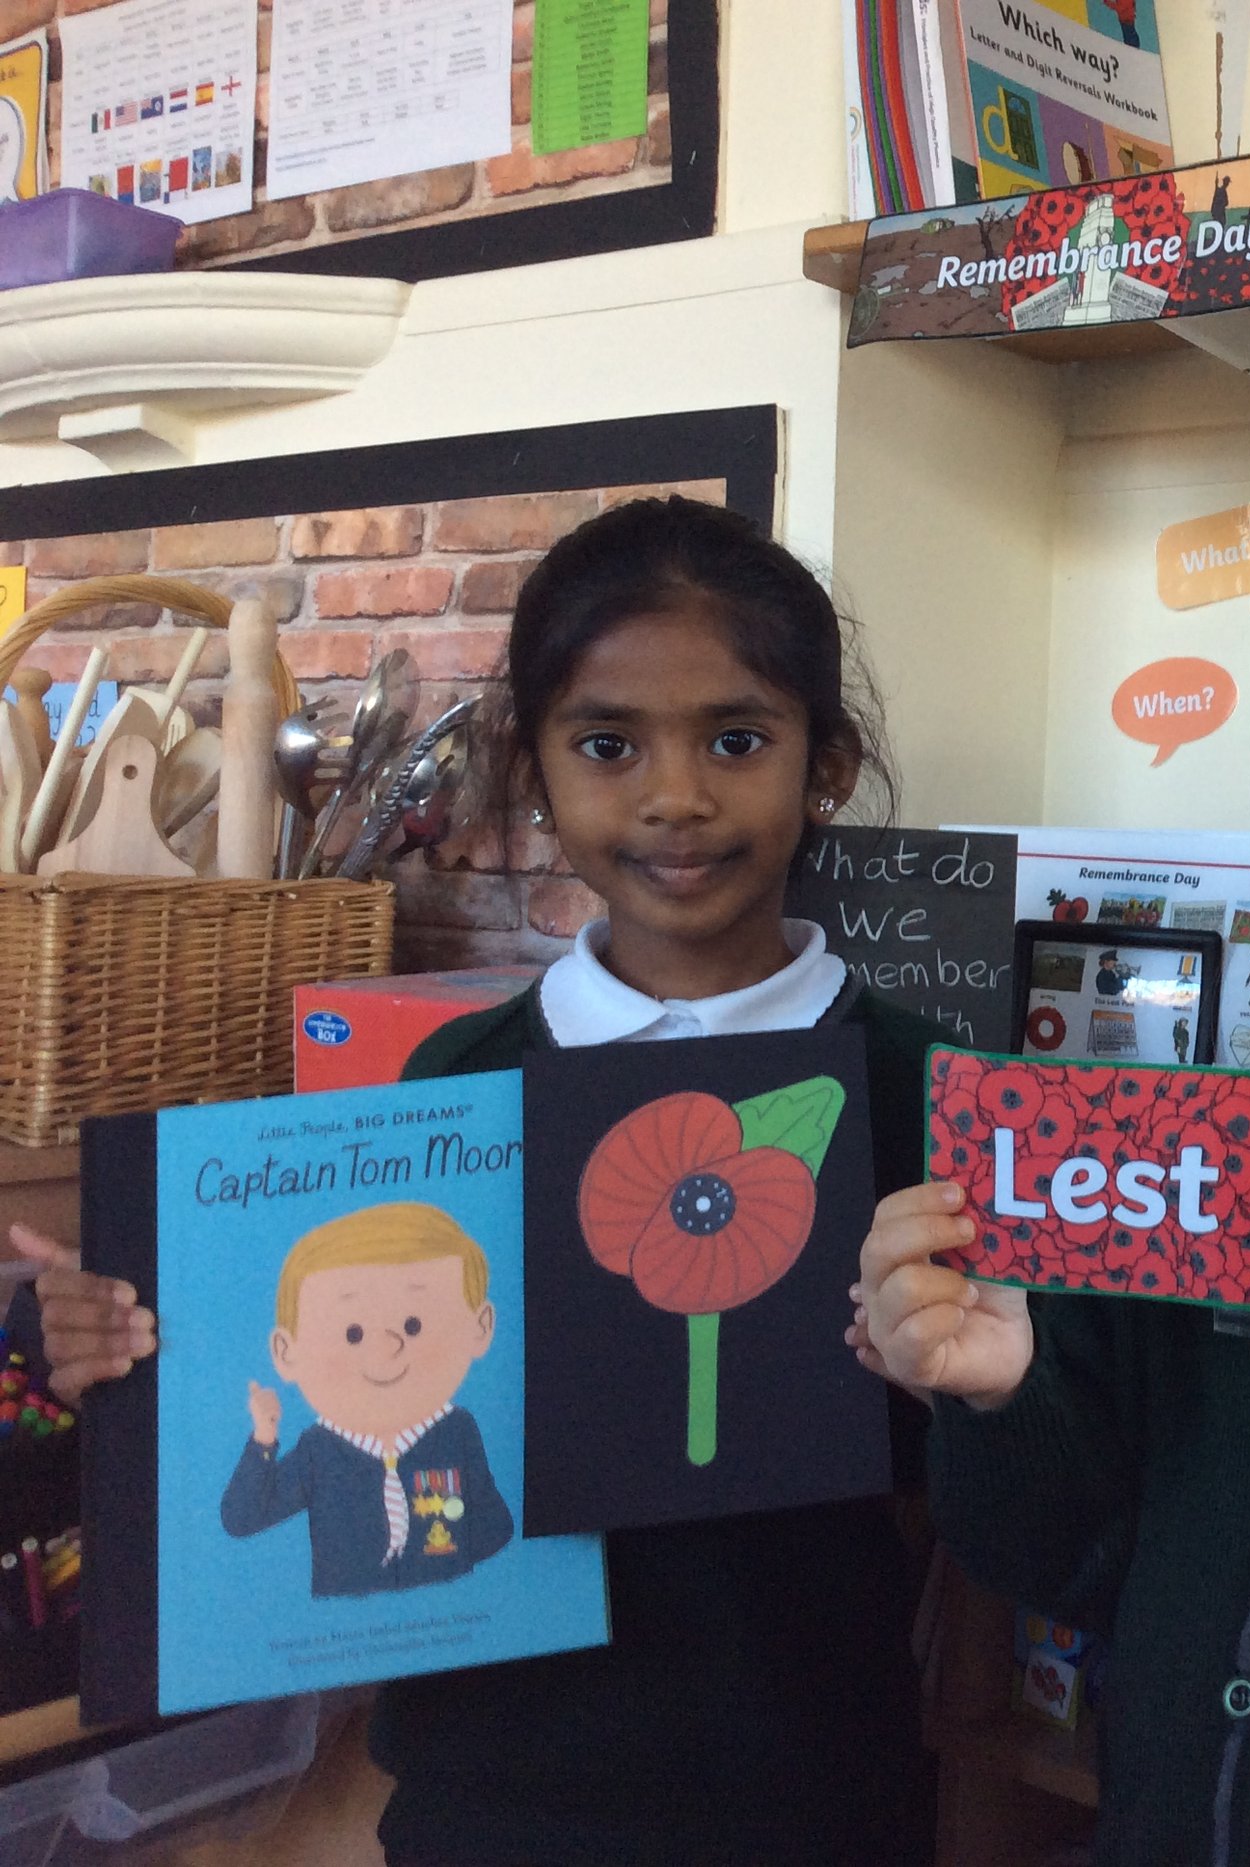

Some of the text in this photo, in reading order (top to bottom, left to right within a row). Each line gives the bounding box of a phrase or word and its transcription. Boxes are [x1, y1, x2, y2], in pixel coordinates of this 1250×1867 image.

[998, 0, 1120, 83] Which way?
[970, 25, 1159, 122] Letter and Digit Reversals Workbook
[936, 230, 1181, 290] Remembrance
[1132, 686, 1215, 719] When?
[931, 837, 995, 888] do
[1078, 866, 1201, 888] Remembrance Day
[848, 947, 1011, 989] member
[354, 1113, 385, 1130] BIG
[195, 1131, 523, 1209] Captain Tom Moor
[993, 1126, 1220, 1234] Lest
